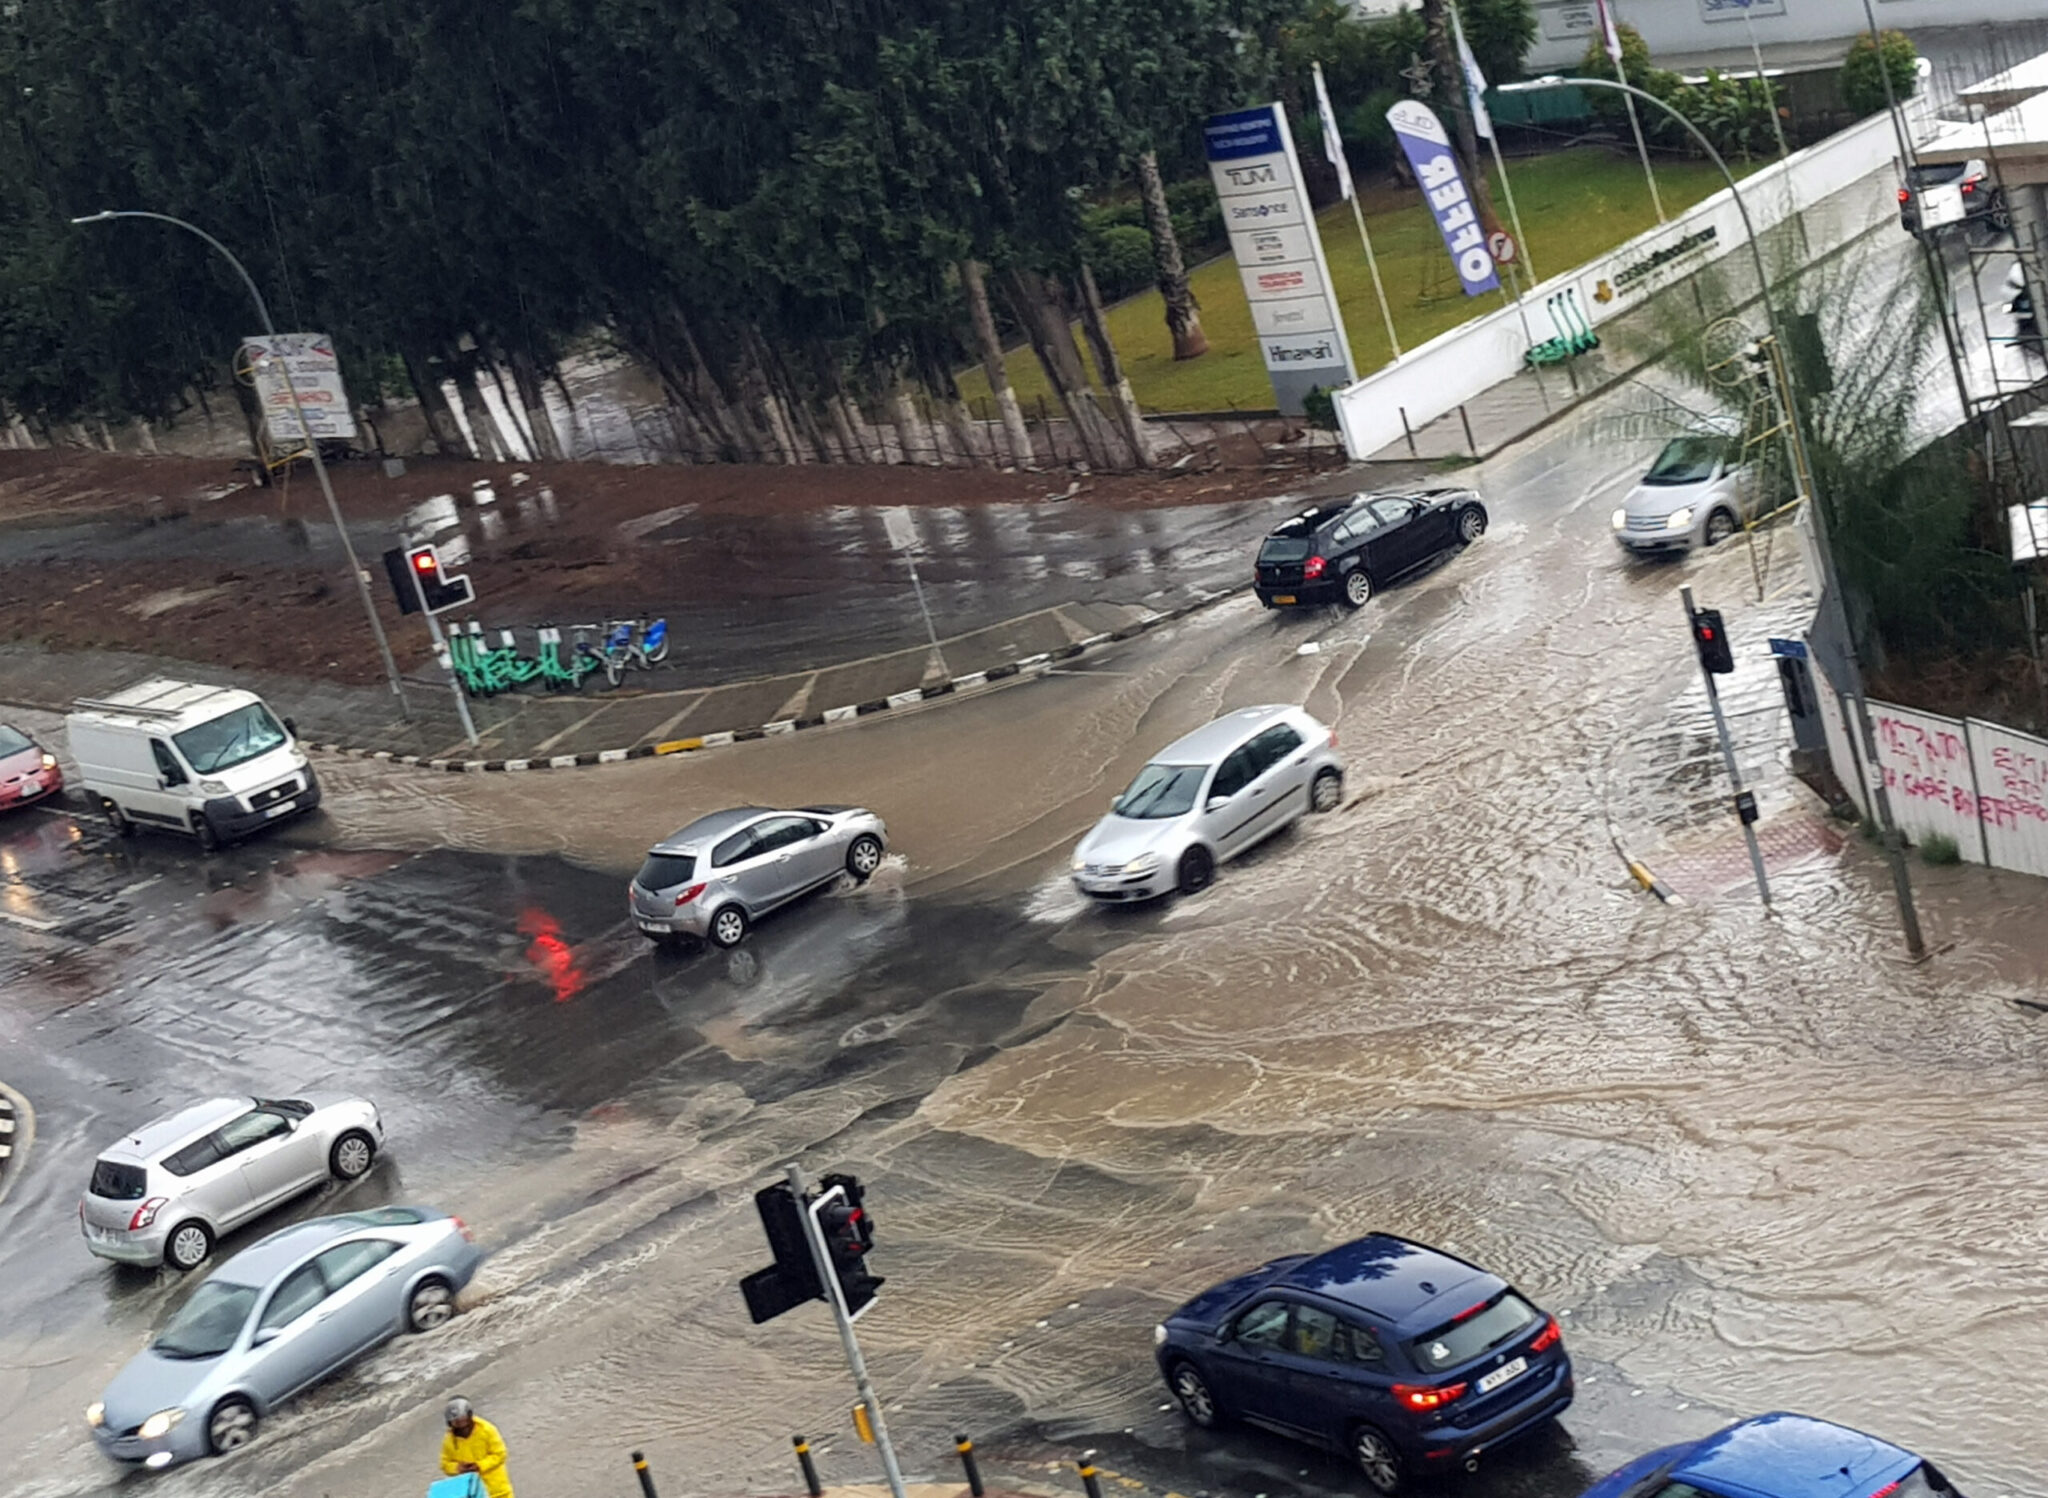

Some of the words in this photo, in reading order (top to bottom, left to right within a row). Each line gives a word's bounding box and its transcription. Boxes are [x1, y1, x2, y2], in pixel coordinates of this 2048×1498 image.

[1225, 163, 1276, 187] TUMI
[1417, 155, 1493, 283] OFFER
[1268, 341, 1333, 365] Himawari
